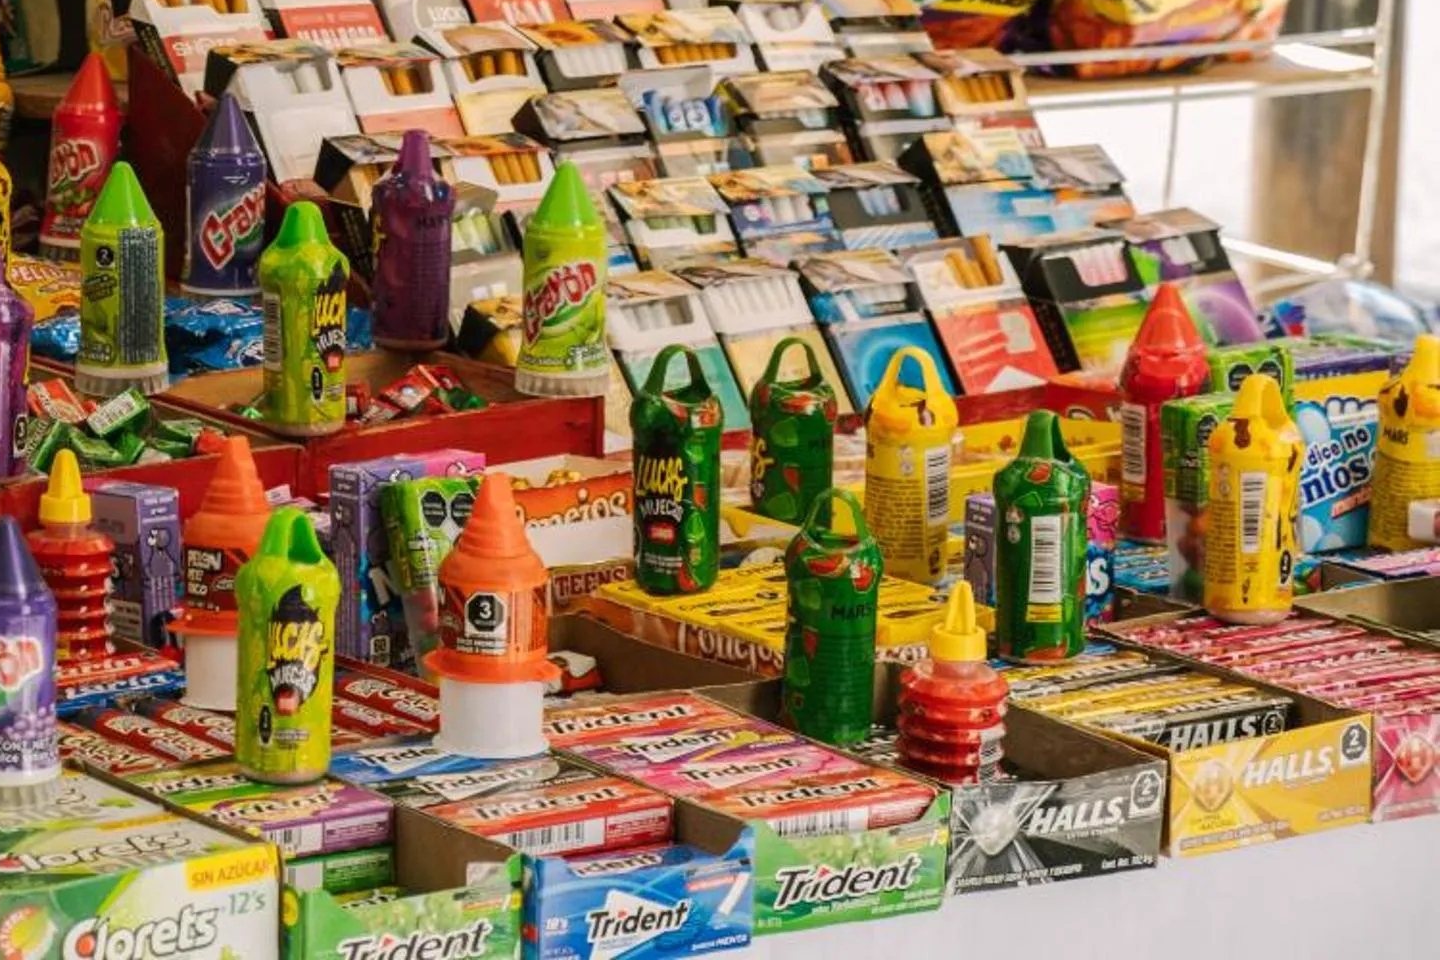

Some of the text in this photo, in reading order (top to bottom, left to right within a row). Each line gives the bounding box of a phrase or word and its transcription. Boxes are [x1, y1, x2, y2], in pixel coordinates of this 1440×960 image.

[523, 261, 598, 342] Crayón
[1307, 425, 1372, 469] dice no
[635, 454, 688, 497] LUCAS
[1302, 457, 1371, 503] ntos
[478, 600, 492, 617] 3
[1169, 715, 1258, 749] HALLS
[1350, 728, 1361, 746] 2
[1143, 777, 1156, 794] 2
[1244, 746, 1336, 789] HALLS
[1027, 797, 1125, 836] HALLS
[191, 857, 274, 887] SIN AZÚCAR
[774, 854, 922, 910] Trident
[227, 892, 266, 916] 12's
[587, 898, 691, 944] Trident
[63, 907, 220, 960] Clorets
[338, 921, 491, 960] Trident
